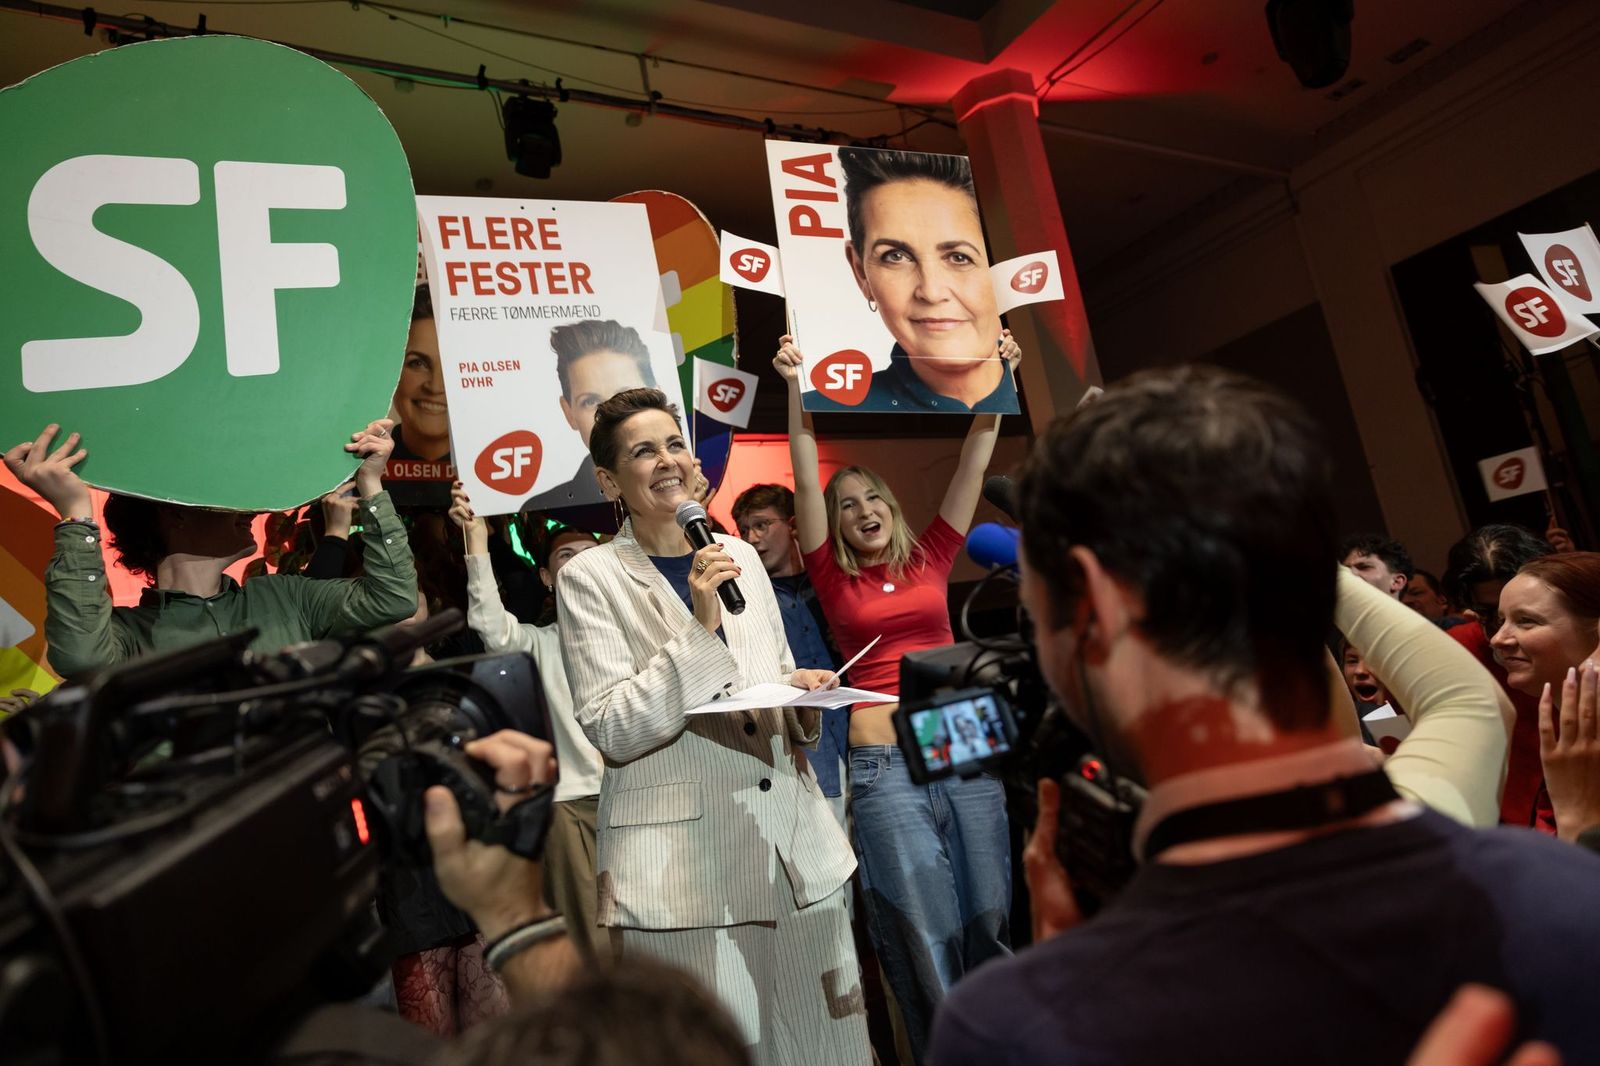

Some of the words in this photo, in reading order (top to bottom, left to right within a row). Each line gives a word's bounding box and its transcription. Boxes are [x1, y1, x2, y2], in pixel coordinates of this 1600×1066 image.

[781, 152, 845, 239] PIA
[437, 215, 562, 250] FLERE
[21, 154, 347, 393] SF
[737, 254, 766, 274] SF
[1018, 265, 1043, 288] SF
[1551, 258, 1580, 287] SF
[445, 261, 594, 296] FESTER
[450, 306, 499, 321] FÆRRE
[501, 304, 601, 320] TØMMERMÆND
[1513, 296, 1549, 329] SF
[459, 362, 479, 373] PIA
[482, 360, 521, 372] OLSEN
[825, 363, 864, 390] SF
[461, 376, 494, 389] DYHR
[712, 384, 740, 404] SF
[393, 463, 441, 478] OLSEN
[490, 446, 533, 480] SF
